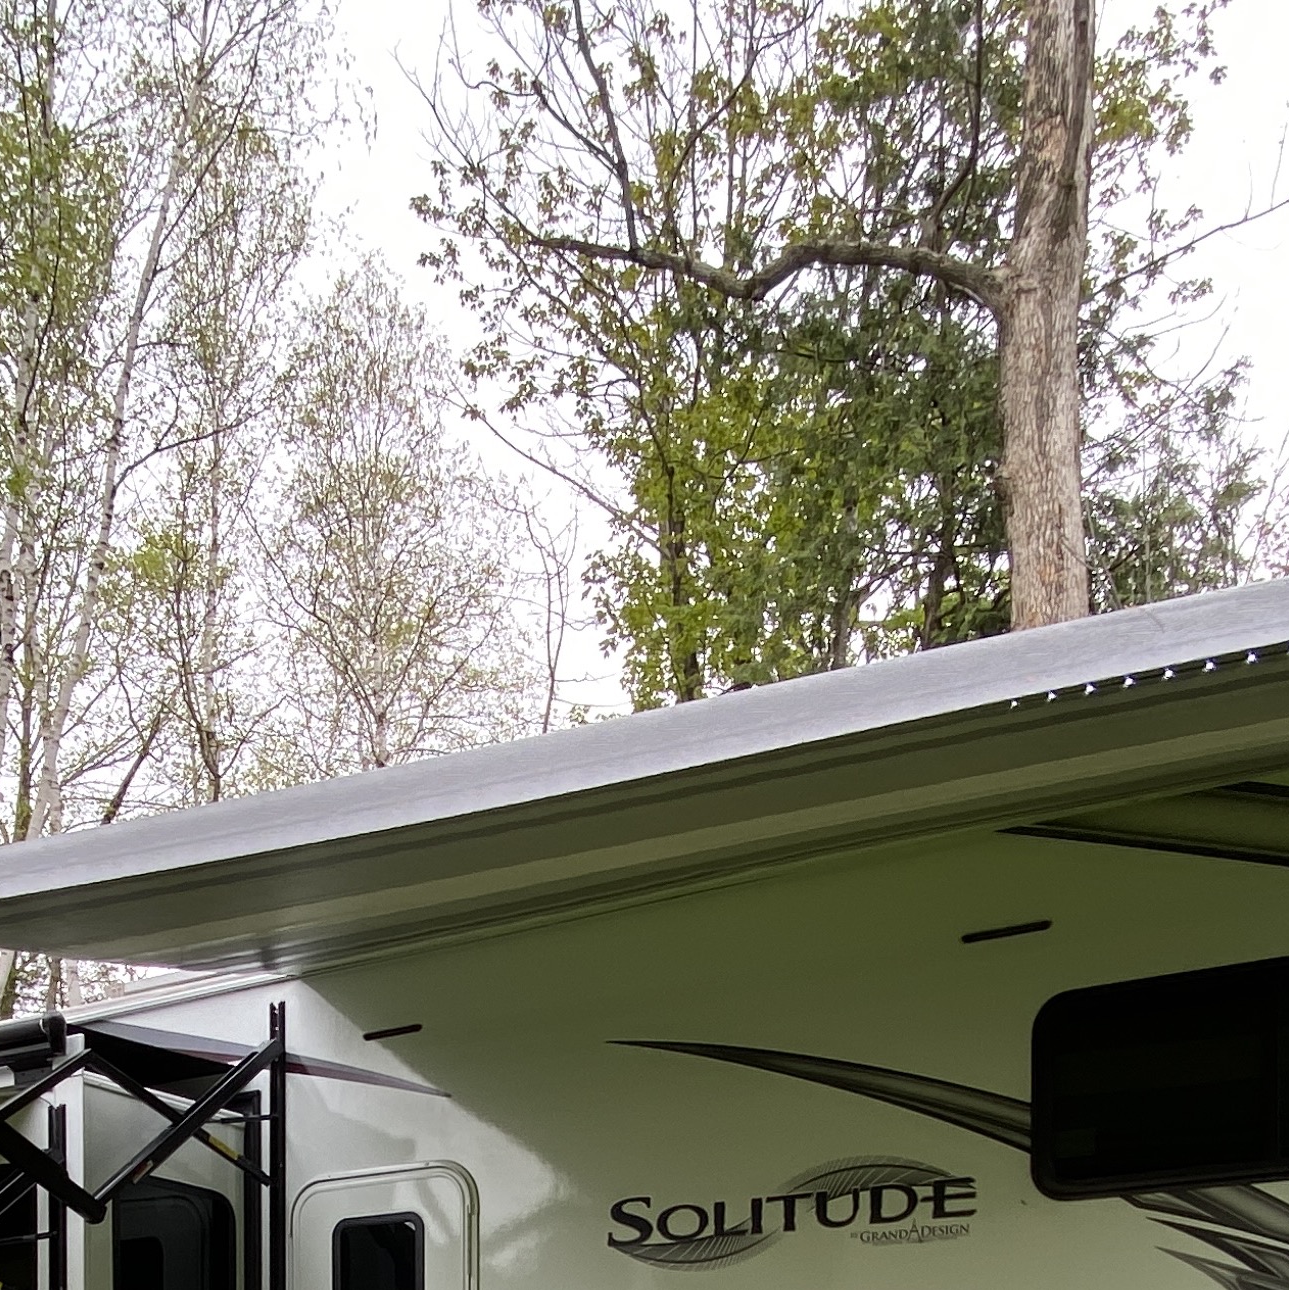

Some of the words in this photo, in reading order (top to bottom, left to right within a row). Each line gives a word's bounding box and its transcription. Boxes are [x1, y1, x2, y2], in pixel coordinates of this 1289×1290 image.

[607, 1176, 978, 1247] SOLITUDE
[860, 1229, 909, 1244] GRAND
[920, 1223, 970, 1240] DESIGN
